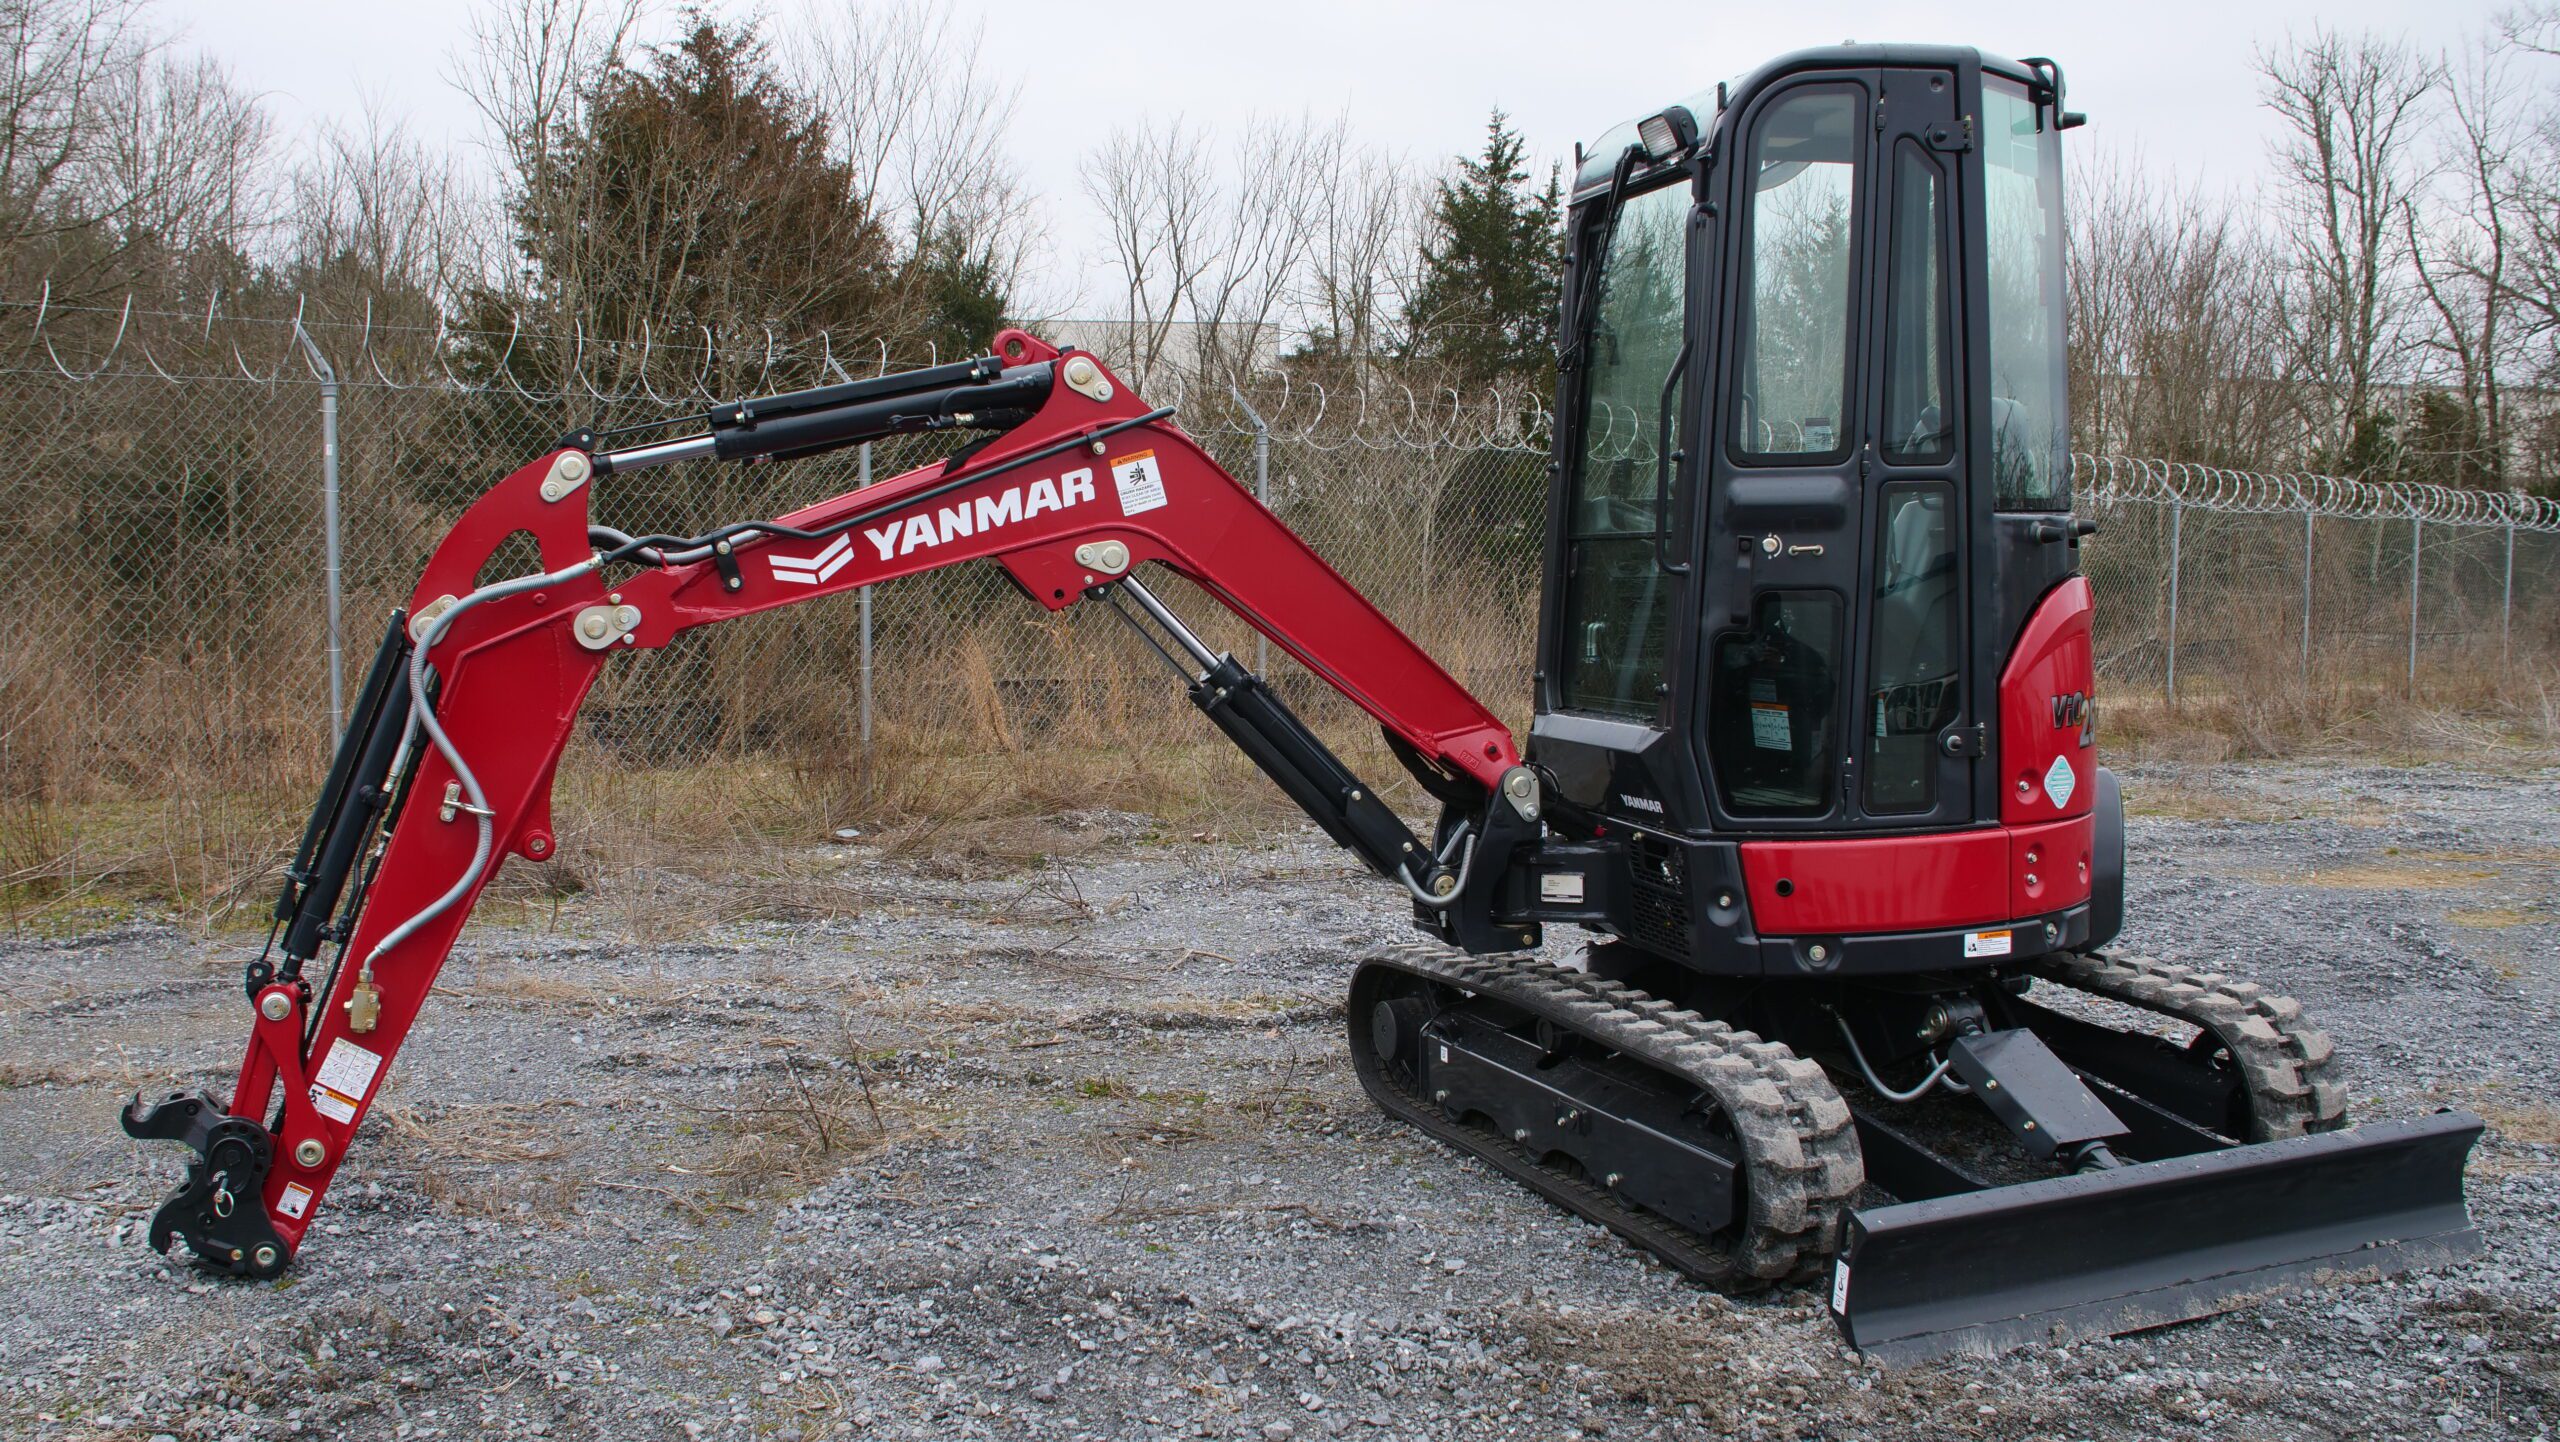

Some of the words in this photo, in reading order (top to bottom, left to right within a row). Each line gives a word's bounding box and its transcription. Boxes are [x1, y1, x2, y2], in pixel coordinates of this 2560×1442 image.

[1121, 451, 1147, 462] WARNING
[864, 467, 1096, 561] YANMAR
[1620, 793, 1664, 814] YANMAR
